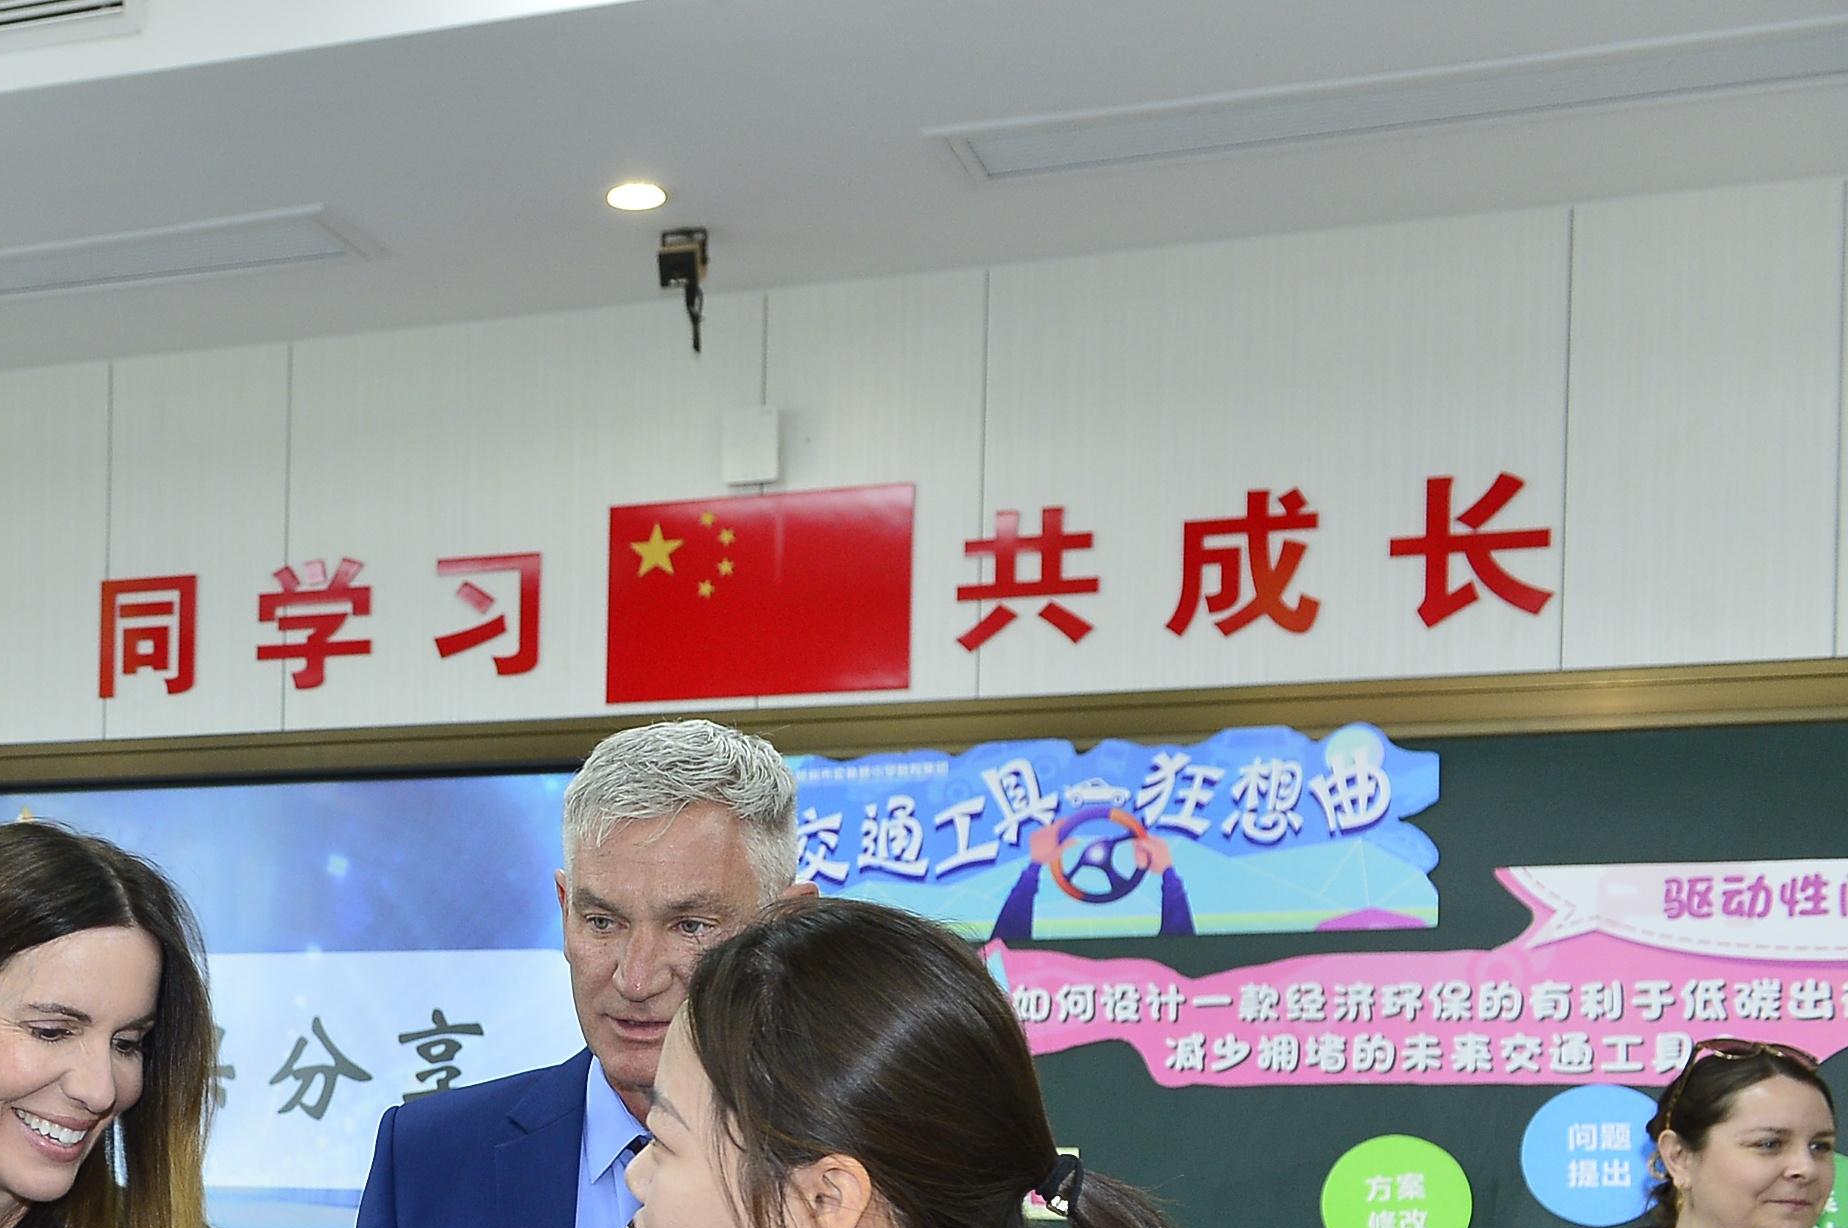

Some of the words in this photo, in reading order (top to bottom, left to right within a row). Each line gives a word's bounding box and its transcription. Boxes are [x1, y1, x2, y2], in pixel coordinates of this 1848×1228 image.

[796, 758, 1059, 884] 交通工具
[1135, 748, 1392, 845] 狂想曲
[1663, 872, 1848, 921] 驱动性
[206, 1007, 485, 1121] 分享
[1164, 1031, 1736, 1075] 减少拥堵的未来交通工具
[1568, 1122, 1632, 1152] 问题
[1365, 1172, 1427, 1203] 方案
[1568, 1159, 1632, 1189] 提出
